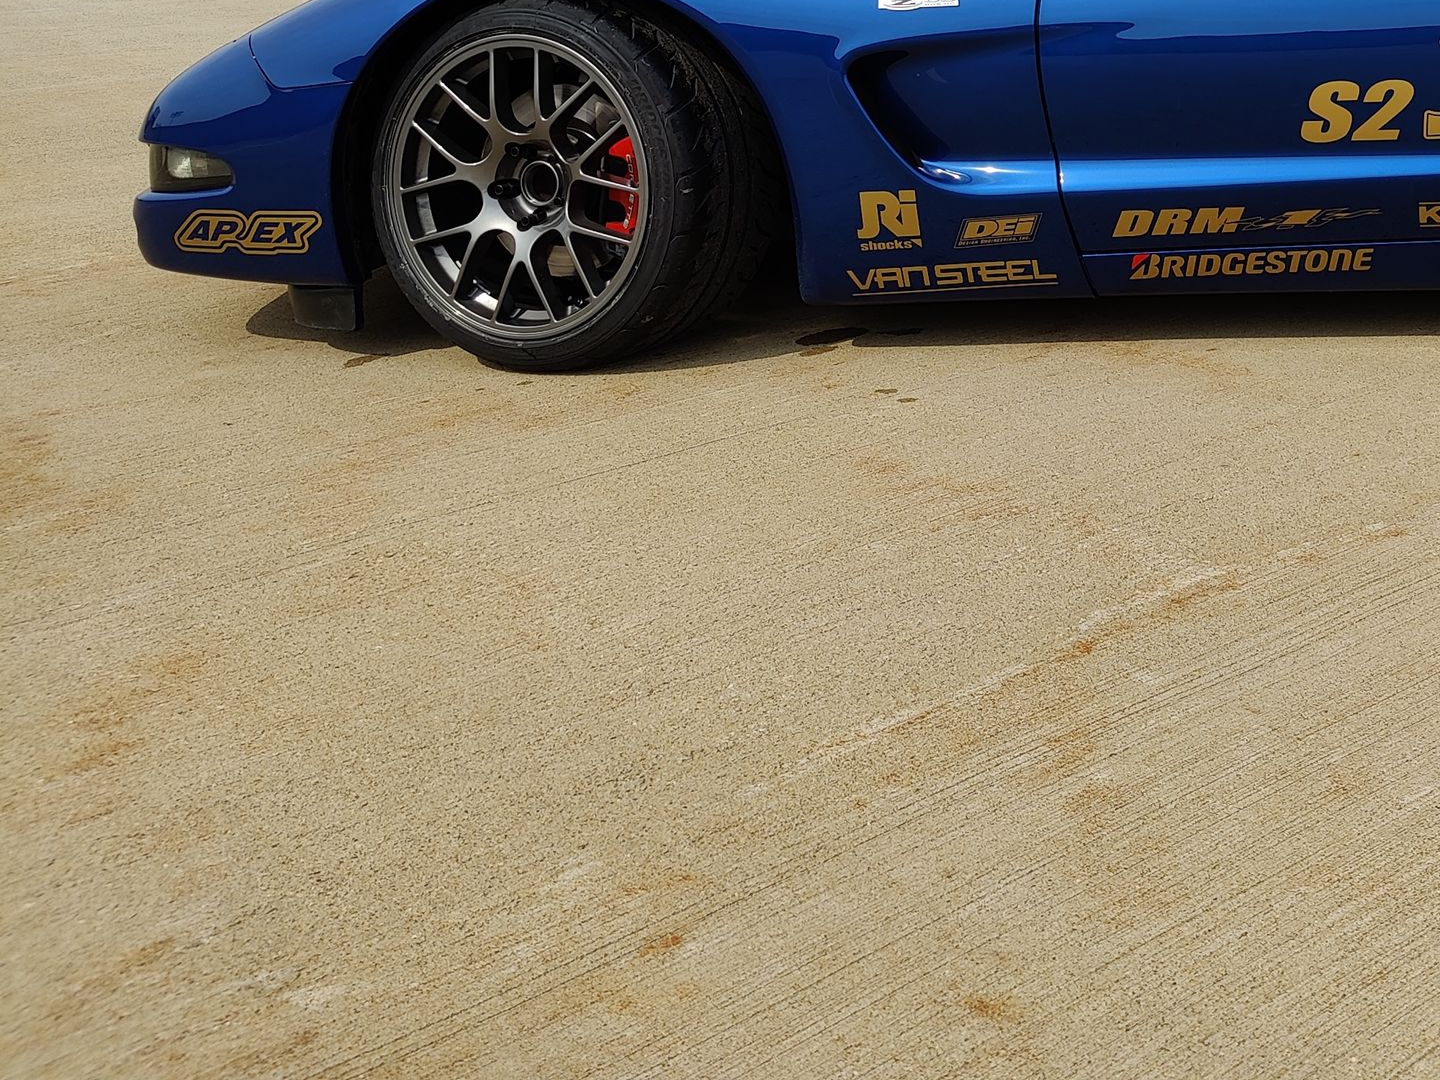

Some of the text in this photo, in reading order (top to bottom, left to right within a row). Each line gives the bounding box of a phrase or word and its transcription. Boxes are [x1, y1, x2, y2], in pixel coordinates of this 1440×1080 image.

[1300, 79, 1415, 143] S2
[1112, 207, 1245, 238] DRM
[860, 239, 913, 252] shocks
[1129, 248, 1375, 280] BRIDGESTONE
